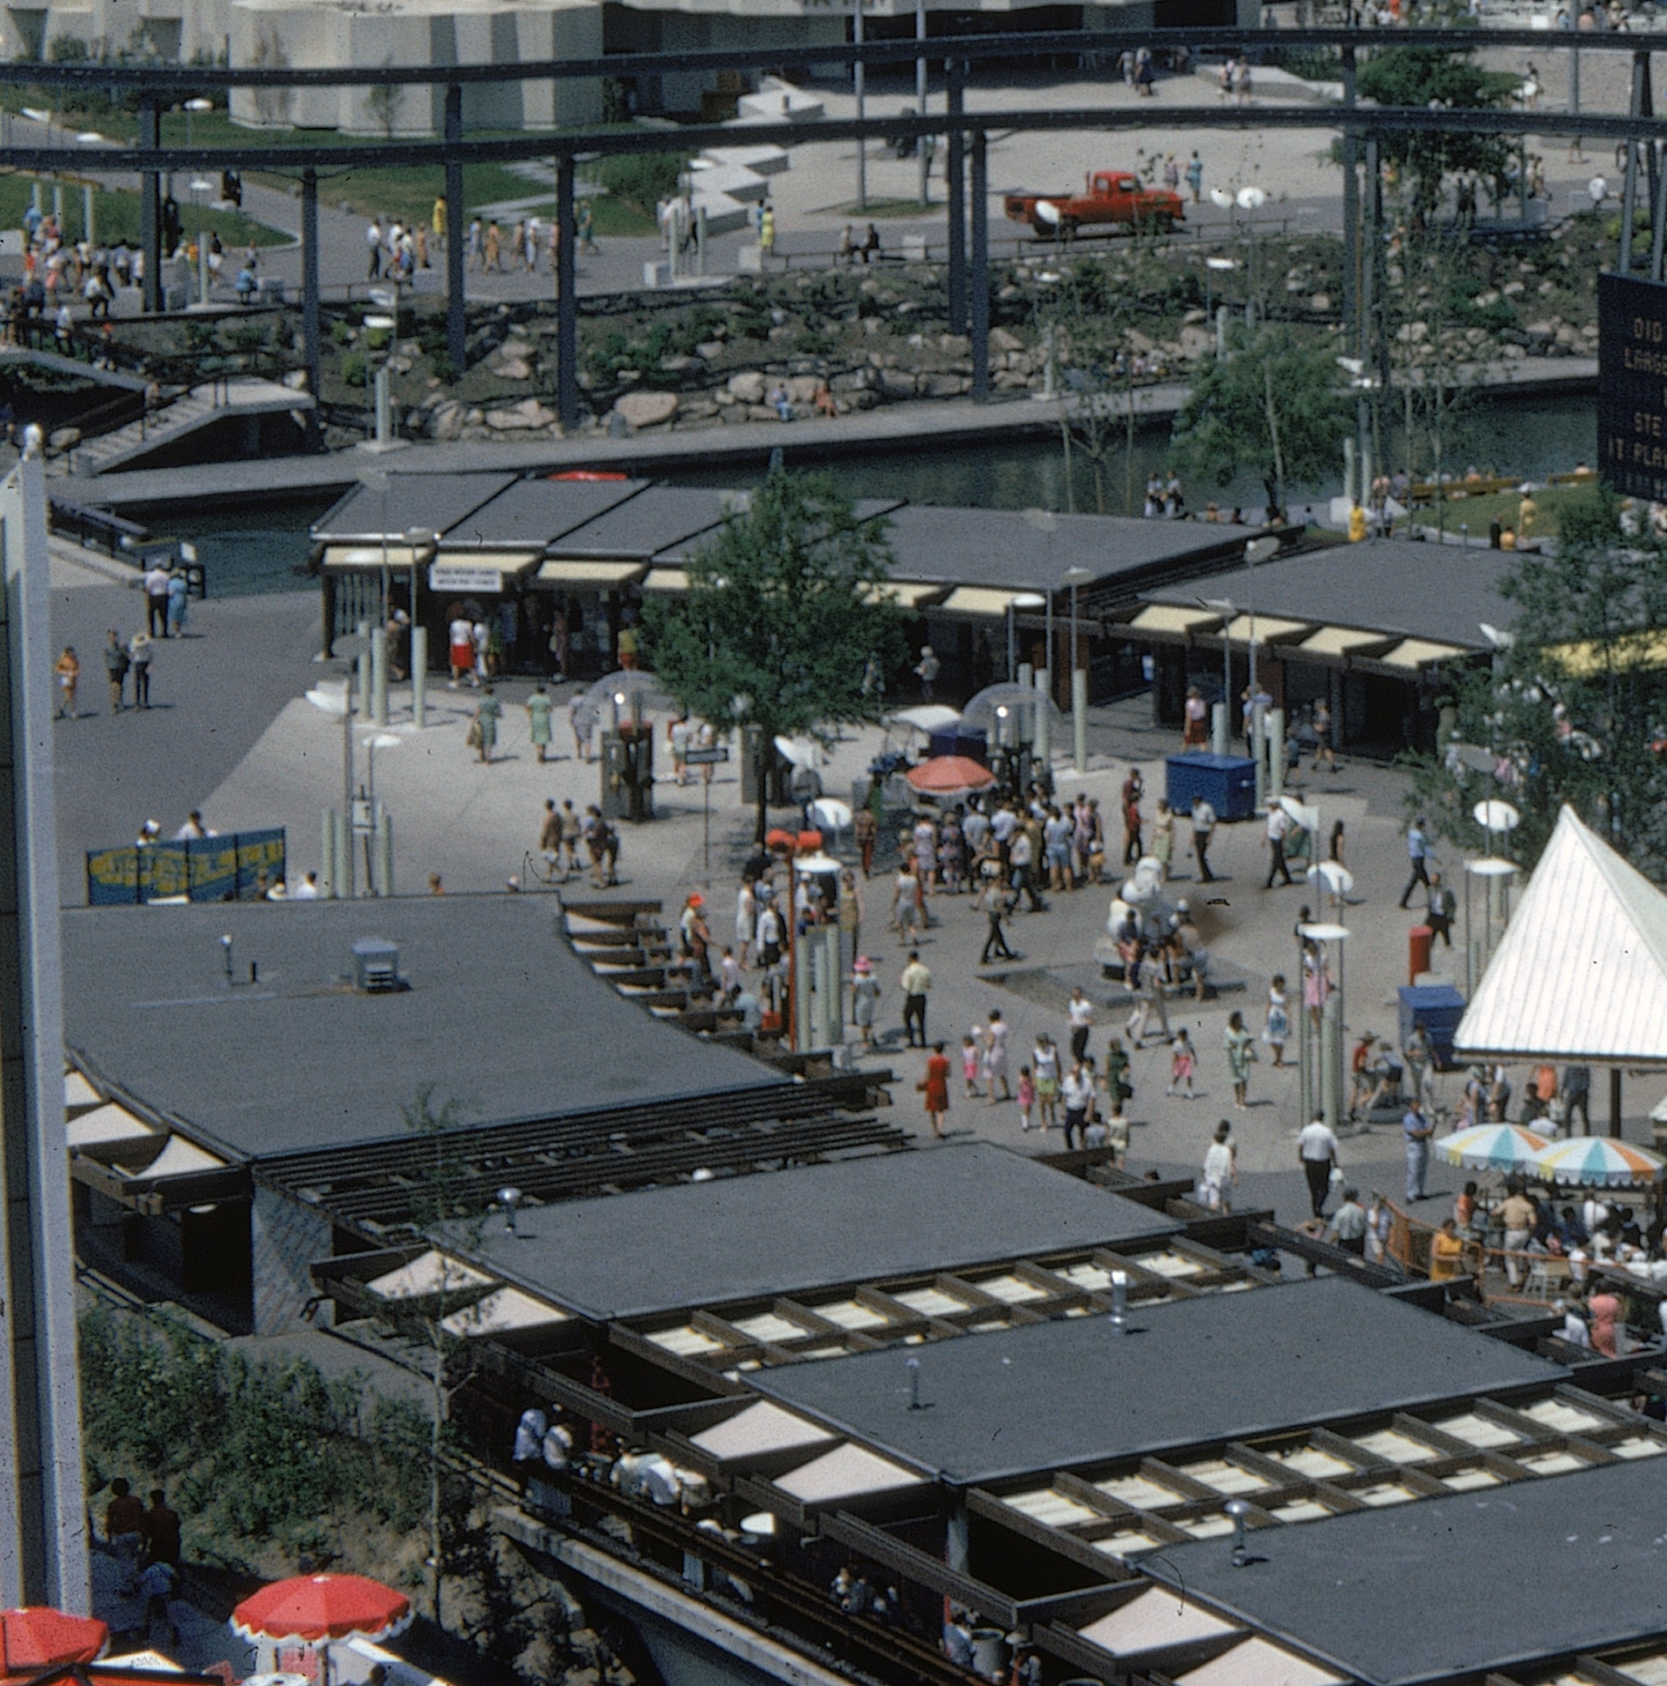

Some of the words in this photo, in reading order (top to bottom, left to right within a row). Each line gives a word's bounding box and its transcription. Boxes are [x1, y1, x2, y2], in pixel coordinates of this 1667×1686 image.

[1633, 316, 1662, 343] DID
[1633, 411, 1662, 438] STE
[1607, 437, 1625, 461] IT
